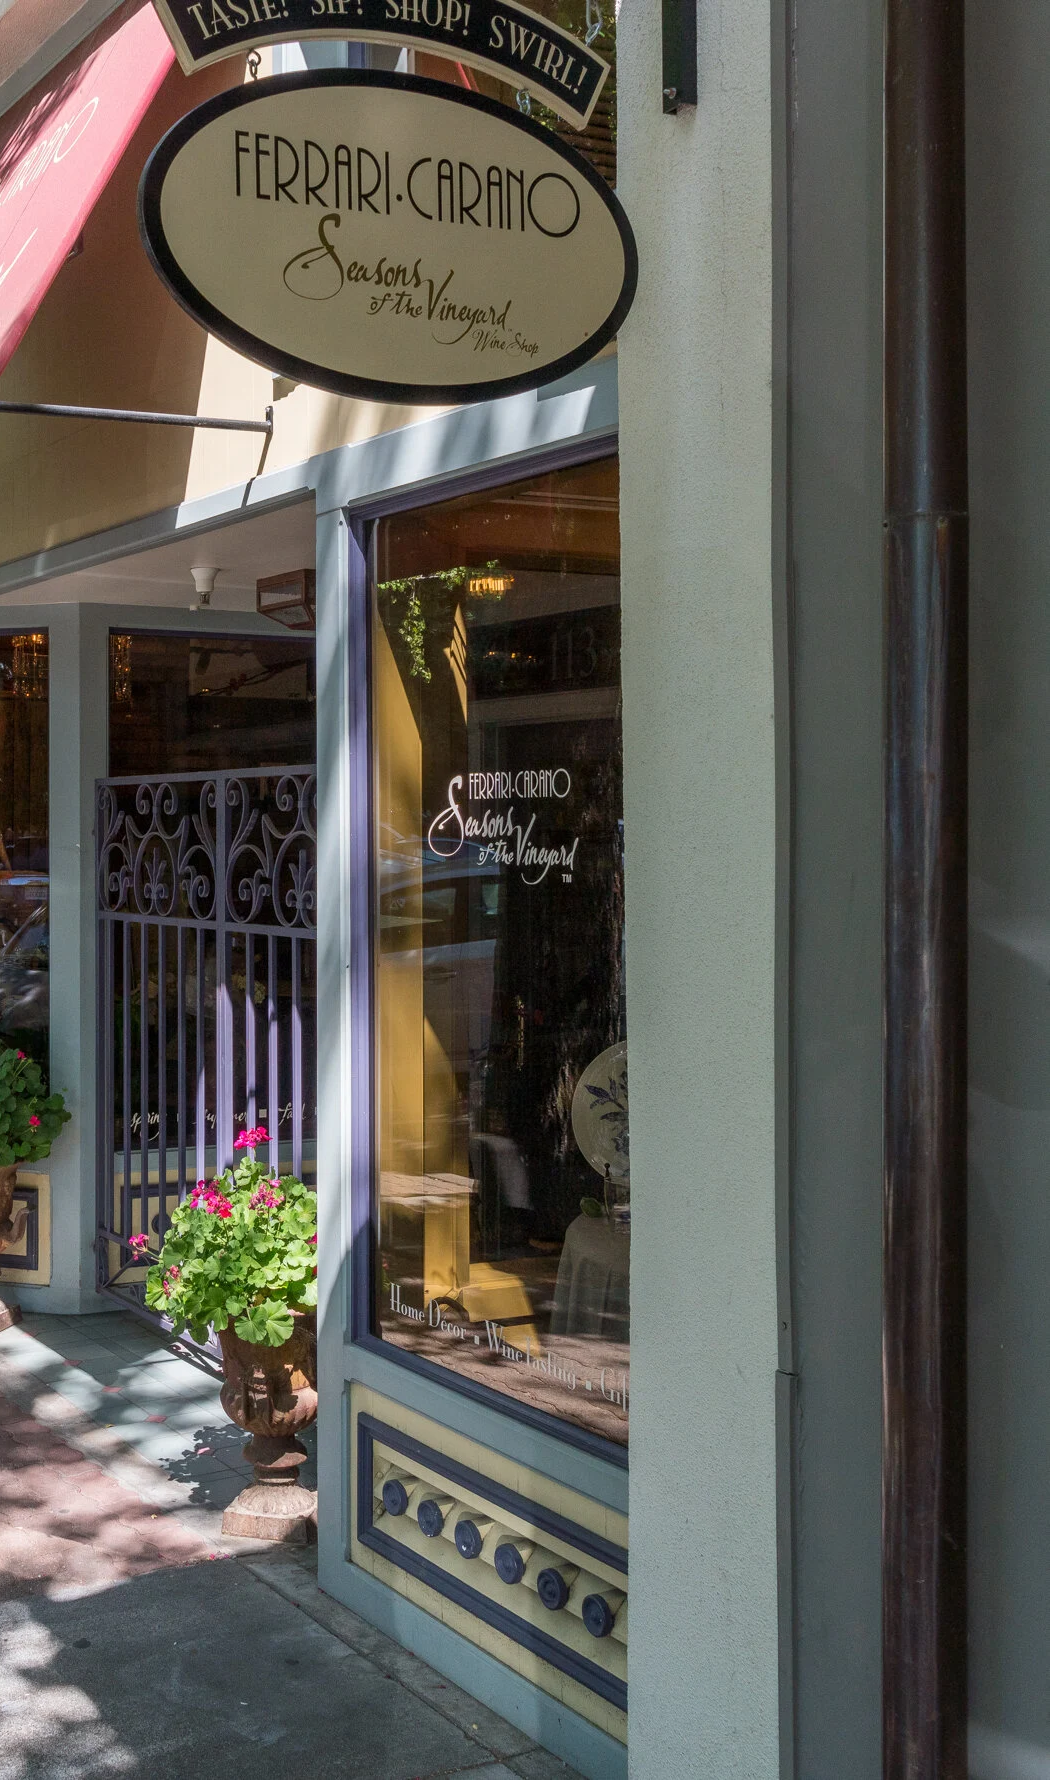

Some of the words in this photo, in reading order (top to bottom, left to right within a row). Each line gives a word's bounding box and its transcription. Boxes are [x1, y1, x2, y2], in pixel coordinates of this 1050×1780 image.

[489, 15, 588, 95] SWIRL!
[283, 212, 422, 301] Seasons
[366, 292, 393, 316] of
[390, 291, 423, 318] the
[422, 269, 513, 345] Vineyard
[472, 329, 506, 352] Wine
[505, 332, 540, 358] Shop
[428, 775, 514, 857] Seasons
[477, 843, 494, 865] of
[492, 839, 514, 864] the
[513, 813, 579, 885] Vineyard
[390, 1282, 425, 1323] Home
[428, 1298, 467, 1341] Décor
[485, 1320, 524, 1364] Wine
[525, 1335, 576, 1390] Tasting
